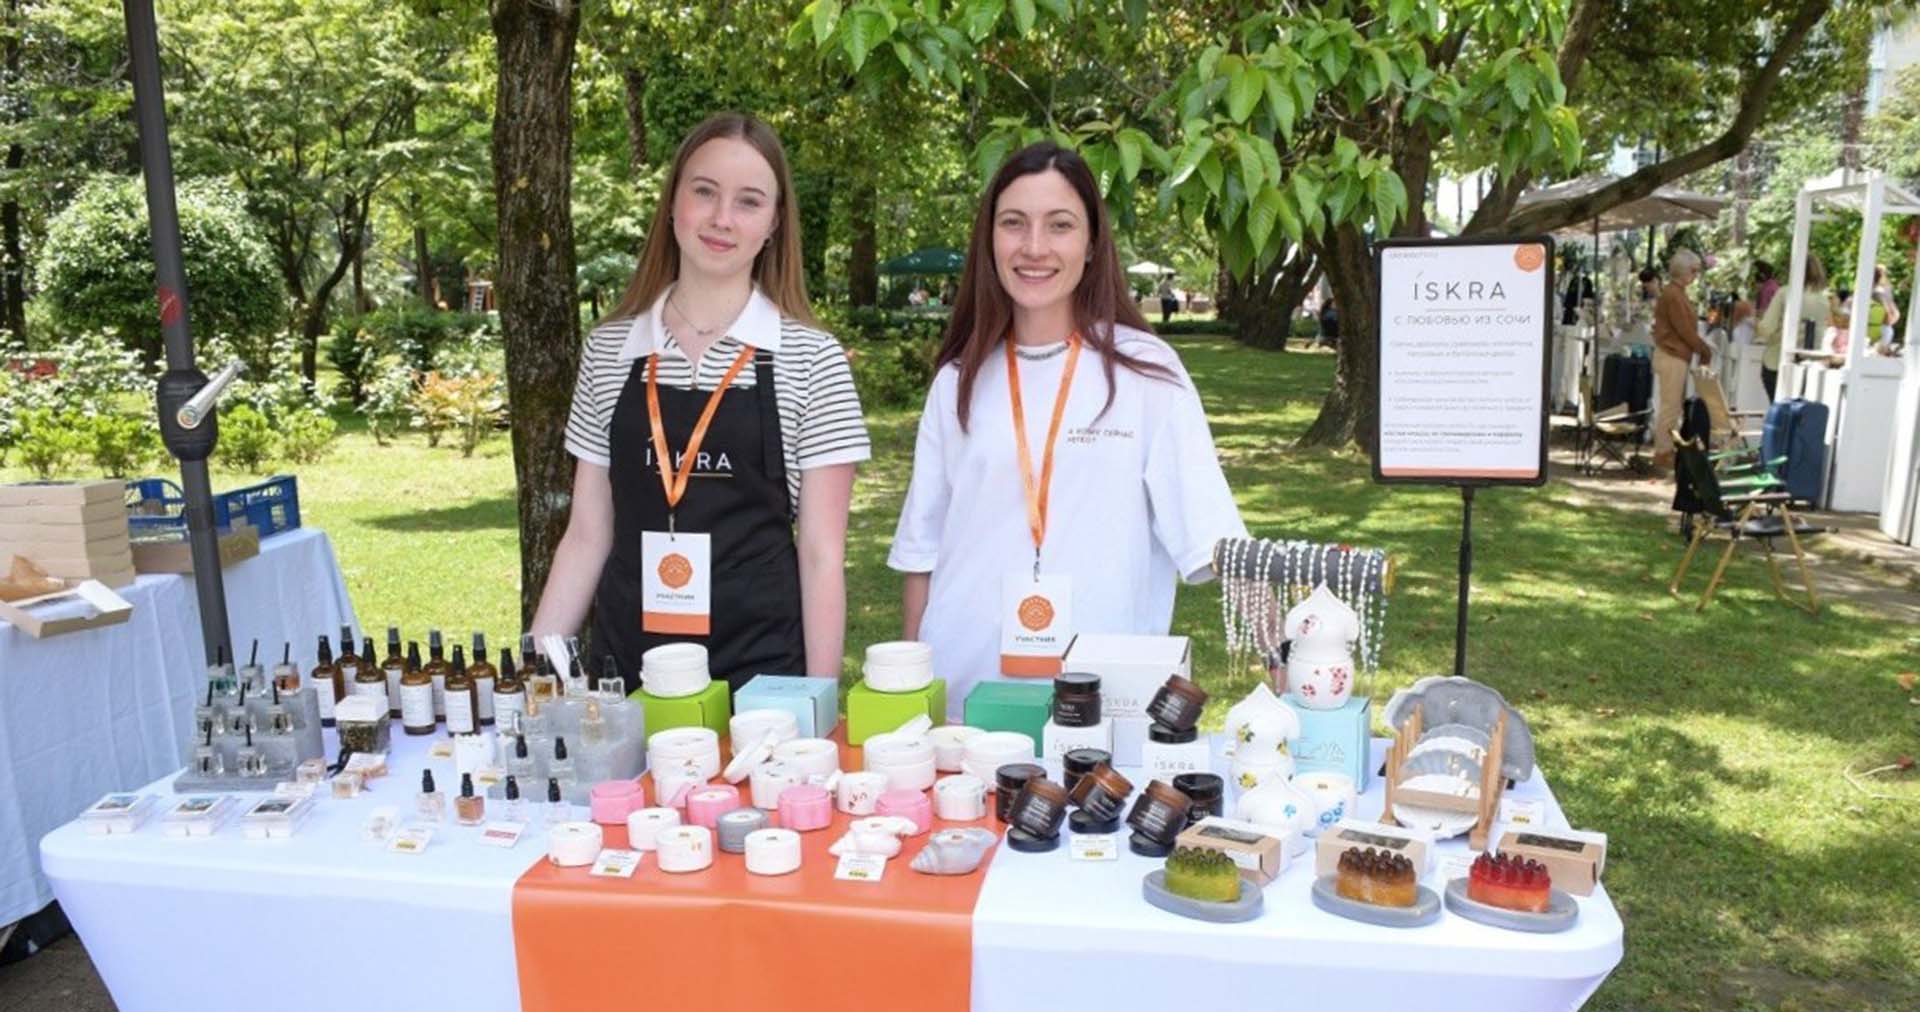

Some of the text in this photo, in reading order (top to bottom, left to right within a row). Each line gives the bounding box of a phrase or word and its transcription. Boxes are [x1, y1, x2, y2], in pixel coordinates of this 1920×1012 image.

[1407, 314, 1470, 326] ЛЮБОВЬЮ
[1475, 314, 1491, 325] ИЗ
[1496, 314, 1531, 326] СОЧИ
